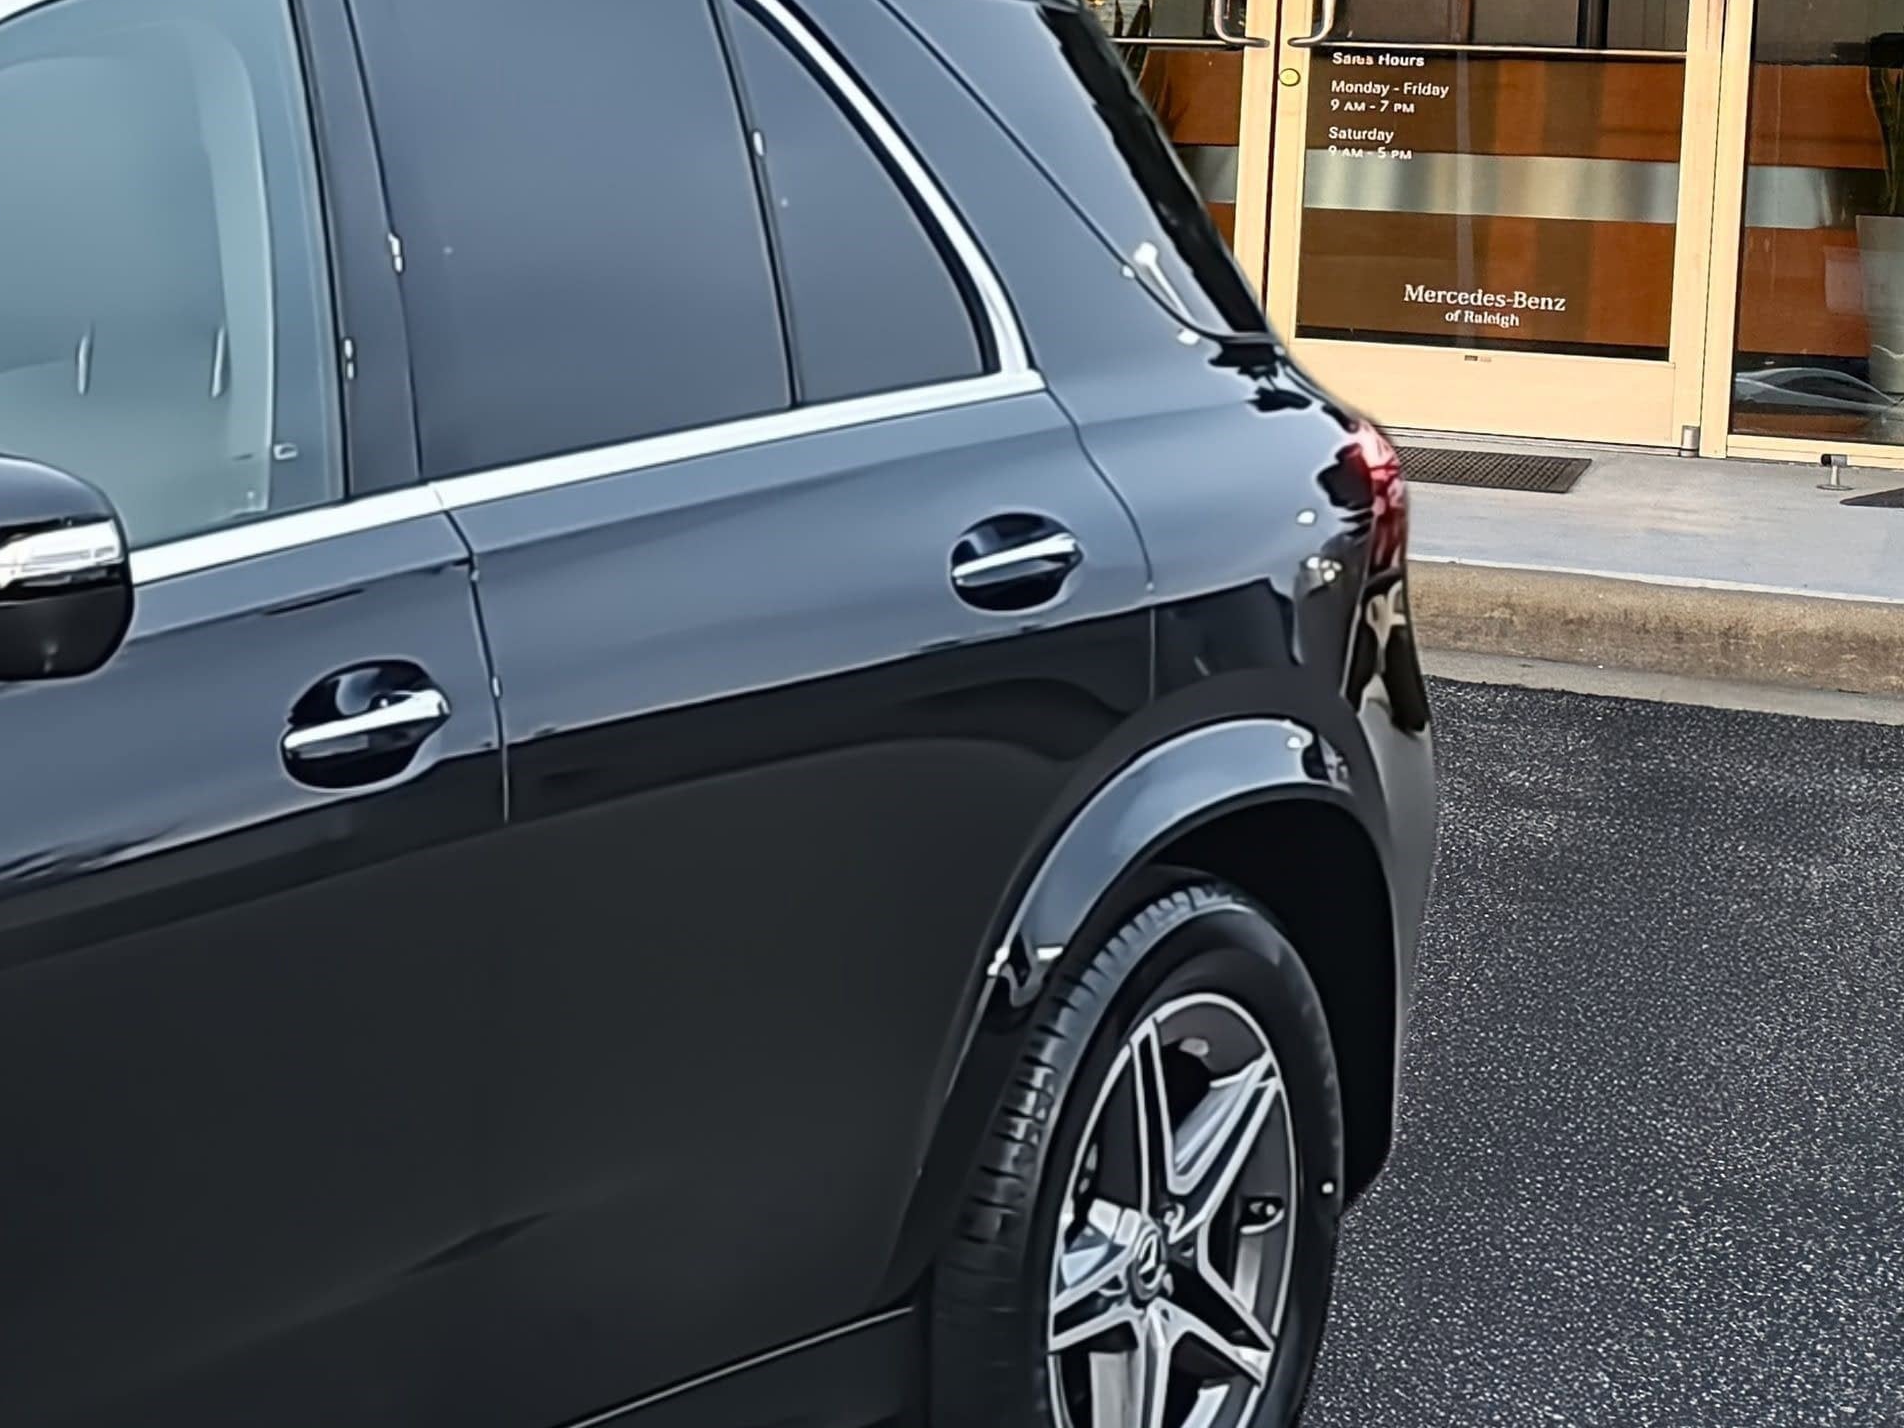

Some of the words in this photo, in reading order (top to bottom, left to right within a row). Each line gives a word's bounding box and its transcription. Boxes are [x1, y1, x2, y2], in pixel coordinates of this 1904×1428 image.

[1378, 53, 1425, 66] Hours
[1331, 80, 1390, 97] Monday
[1403, 82, 1450, 98] Friday
[1330, 99, 1340, 111] 9
[1343, 101, 1366, 111] AM
[1379, 100, 1389, 112] 7
[1393, 103, 1415, 113] PM
[1328, 126, 1394, 144] Saturday
[1328, 145, 1337, 157] 9
[1390, 150, 1413, 160] PM
[1403, 284, 1566, 312] Mercedes-Benz
[1445, 309, 1462, 322] of
